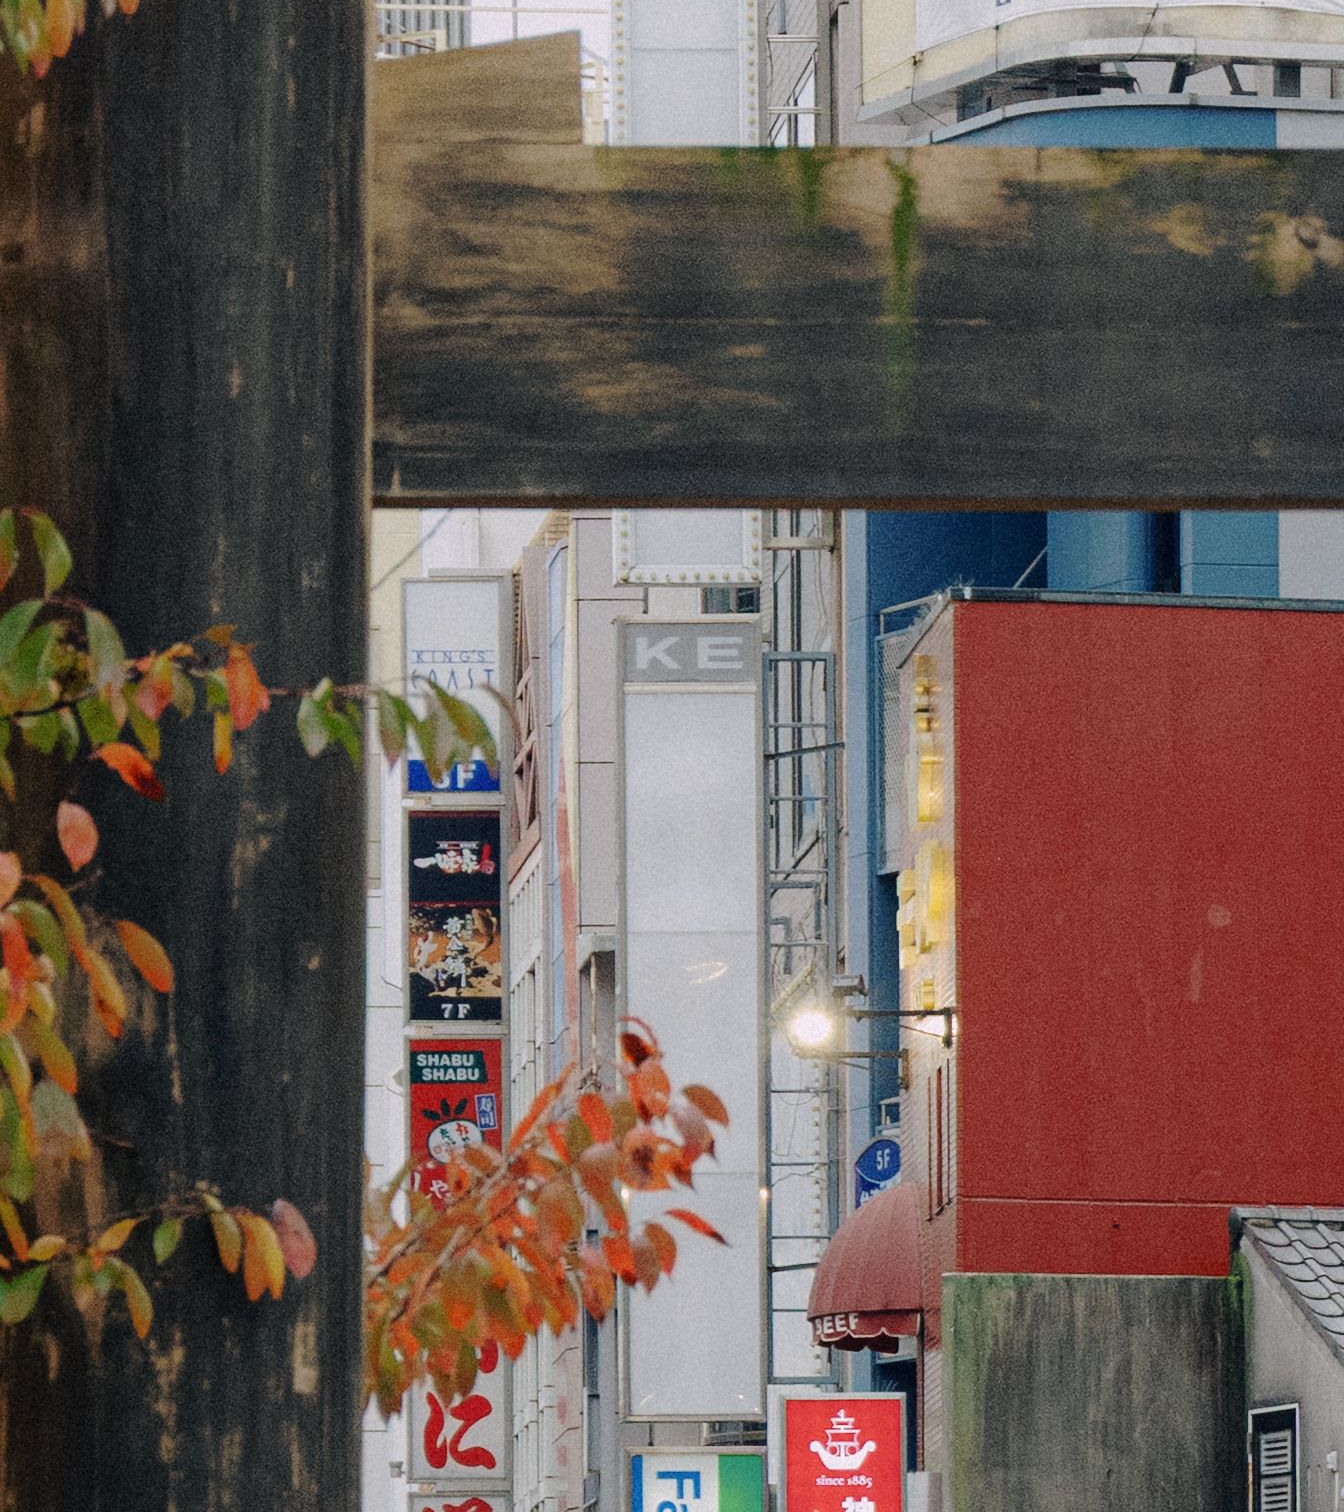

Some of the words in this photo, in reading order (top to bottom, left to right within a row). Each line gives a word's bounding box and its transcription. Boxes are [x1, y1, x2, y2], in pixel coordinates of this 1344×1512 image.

[416, 1054, 474, 1067] SHABU
[422, 1068, 480, 1081] SHABU
[816, 1476, 844, 1487] since
[846, 1476, 873, 1489] 1885
